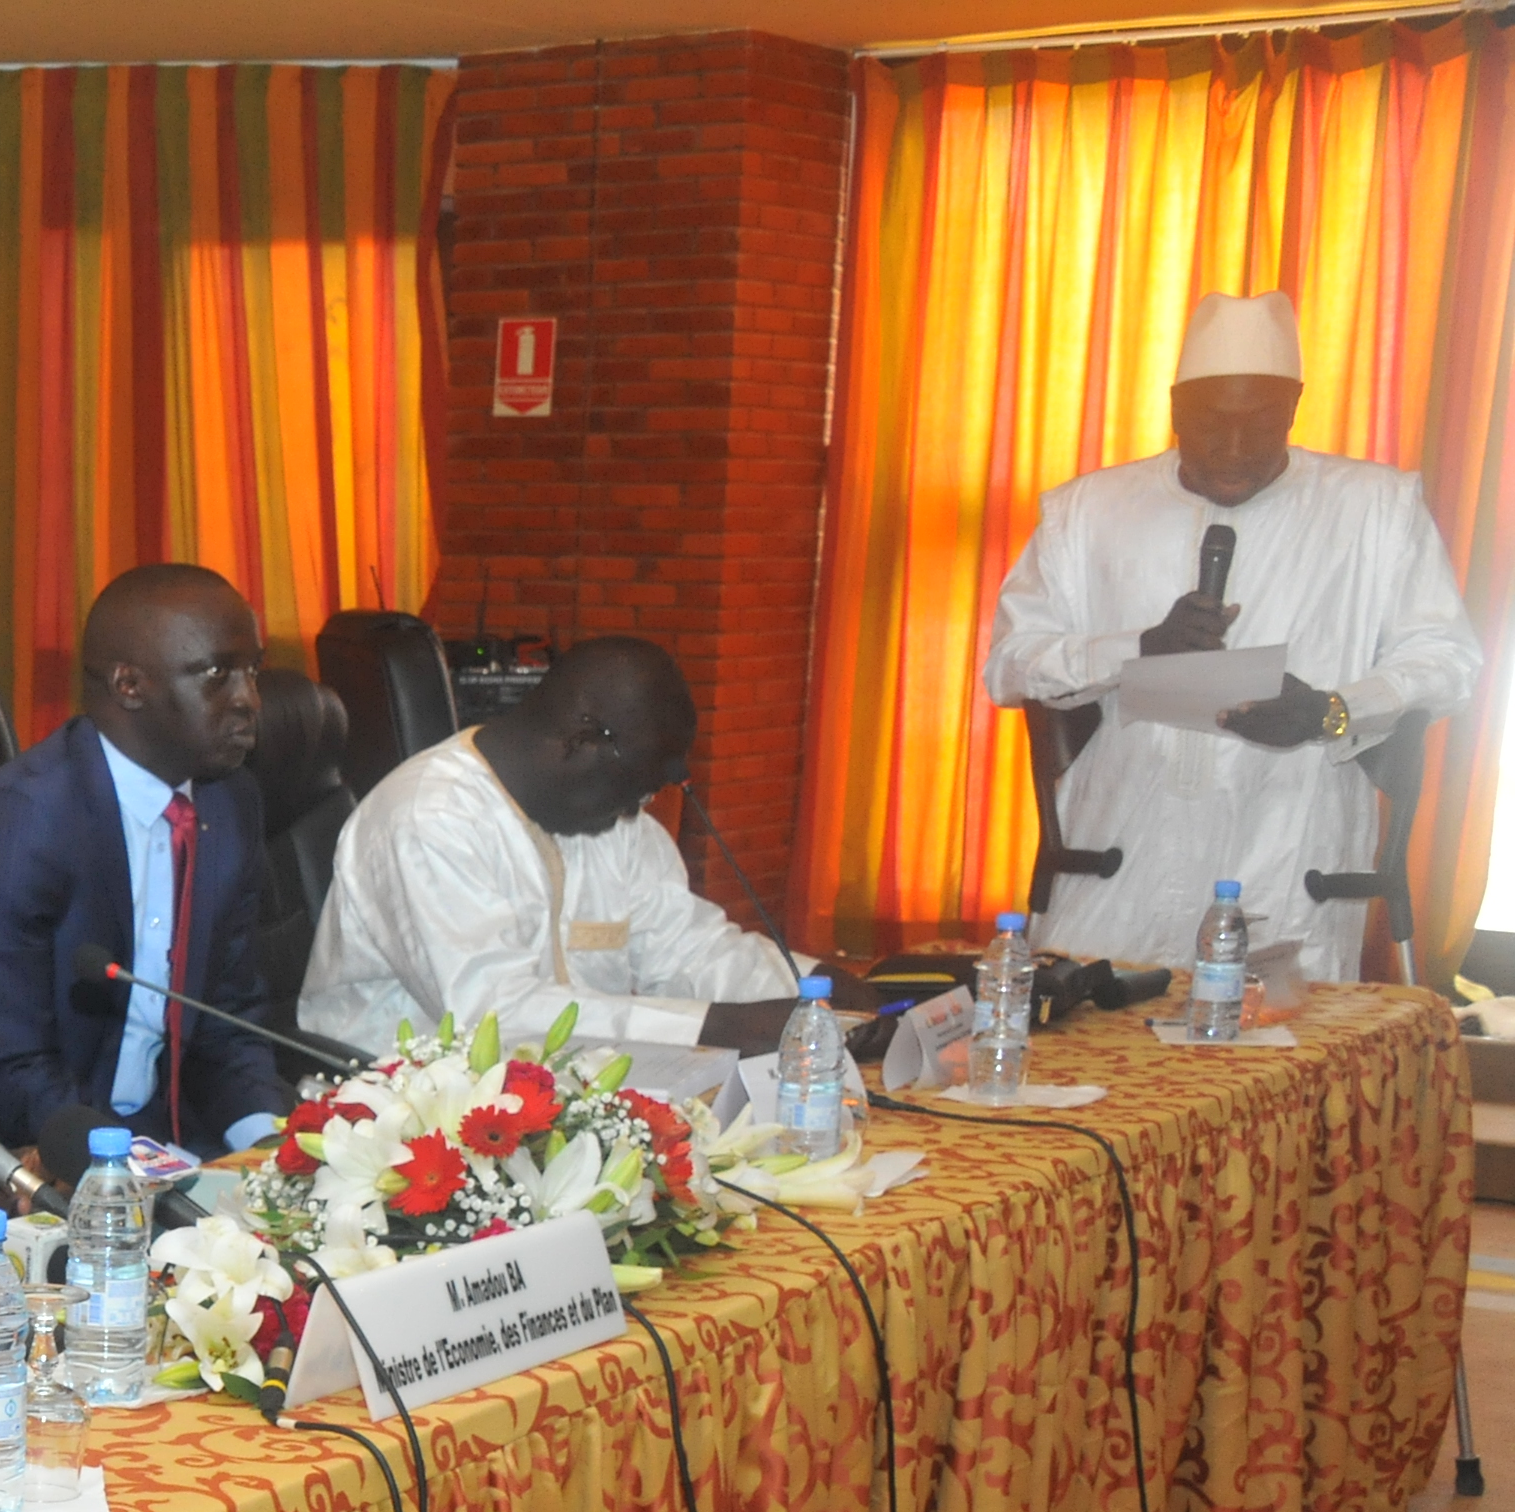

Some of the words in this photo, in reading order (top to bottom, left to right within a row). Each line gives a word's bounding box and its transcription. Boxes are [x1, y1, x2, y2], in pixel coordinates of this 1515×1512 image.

[446, 1277, 465, 1312] M.
[462, 1268, 509, 1307] Amadou
[505, 1260, 527, 1295] BA
[422, 1345, 439, 1375] de
[500, 1318, 522, 1351] des
[518, 1304, 569, 1342] Finances
[566, 1302, 582, 1329] et
[581, 1296, 596, 1323] du
[592, 1286, 618, 1319] Plan
